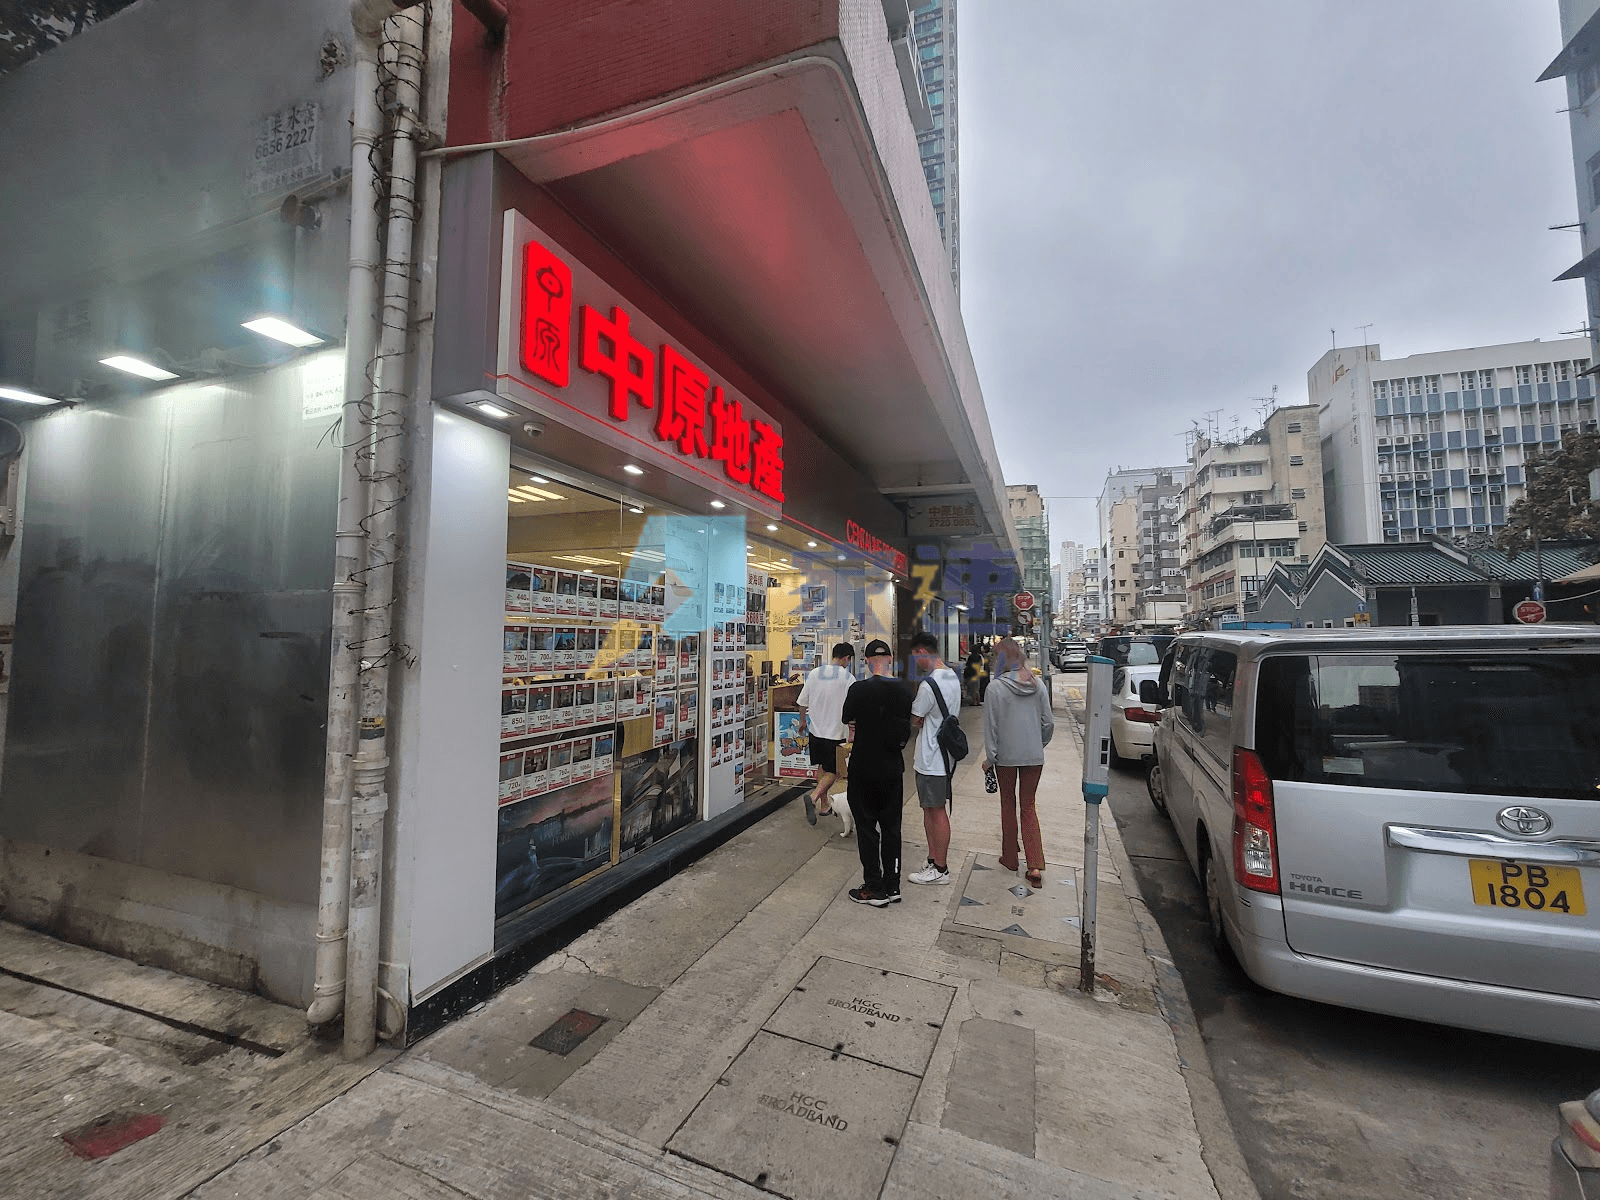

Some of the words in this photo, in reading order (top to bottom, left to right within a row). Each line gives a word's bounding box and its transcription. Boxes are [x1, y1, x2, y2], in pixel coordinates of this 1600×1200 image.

[285, 125, 315, 150] 2227
[578, 304, 785, 502] 中原地產
[928, 503, 976, 516] 中原地產
[928, 519, 951, 528] 2720
[1290, 873, 1323, 884] TOYOTA
[1501, 863, 1550, 889] PB
[1289, 881, 1363, 900] HIACE
[1488, 882, 1570, 914] 1804
[826, 998, 901, 1023] BROADBAND
[852, 997, 882, 1010] HGC
[790, 1091, 828, 1111] HGC
[757, 1094, 849, 1132] BROADBAND
